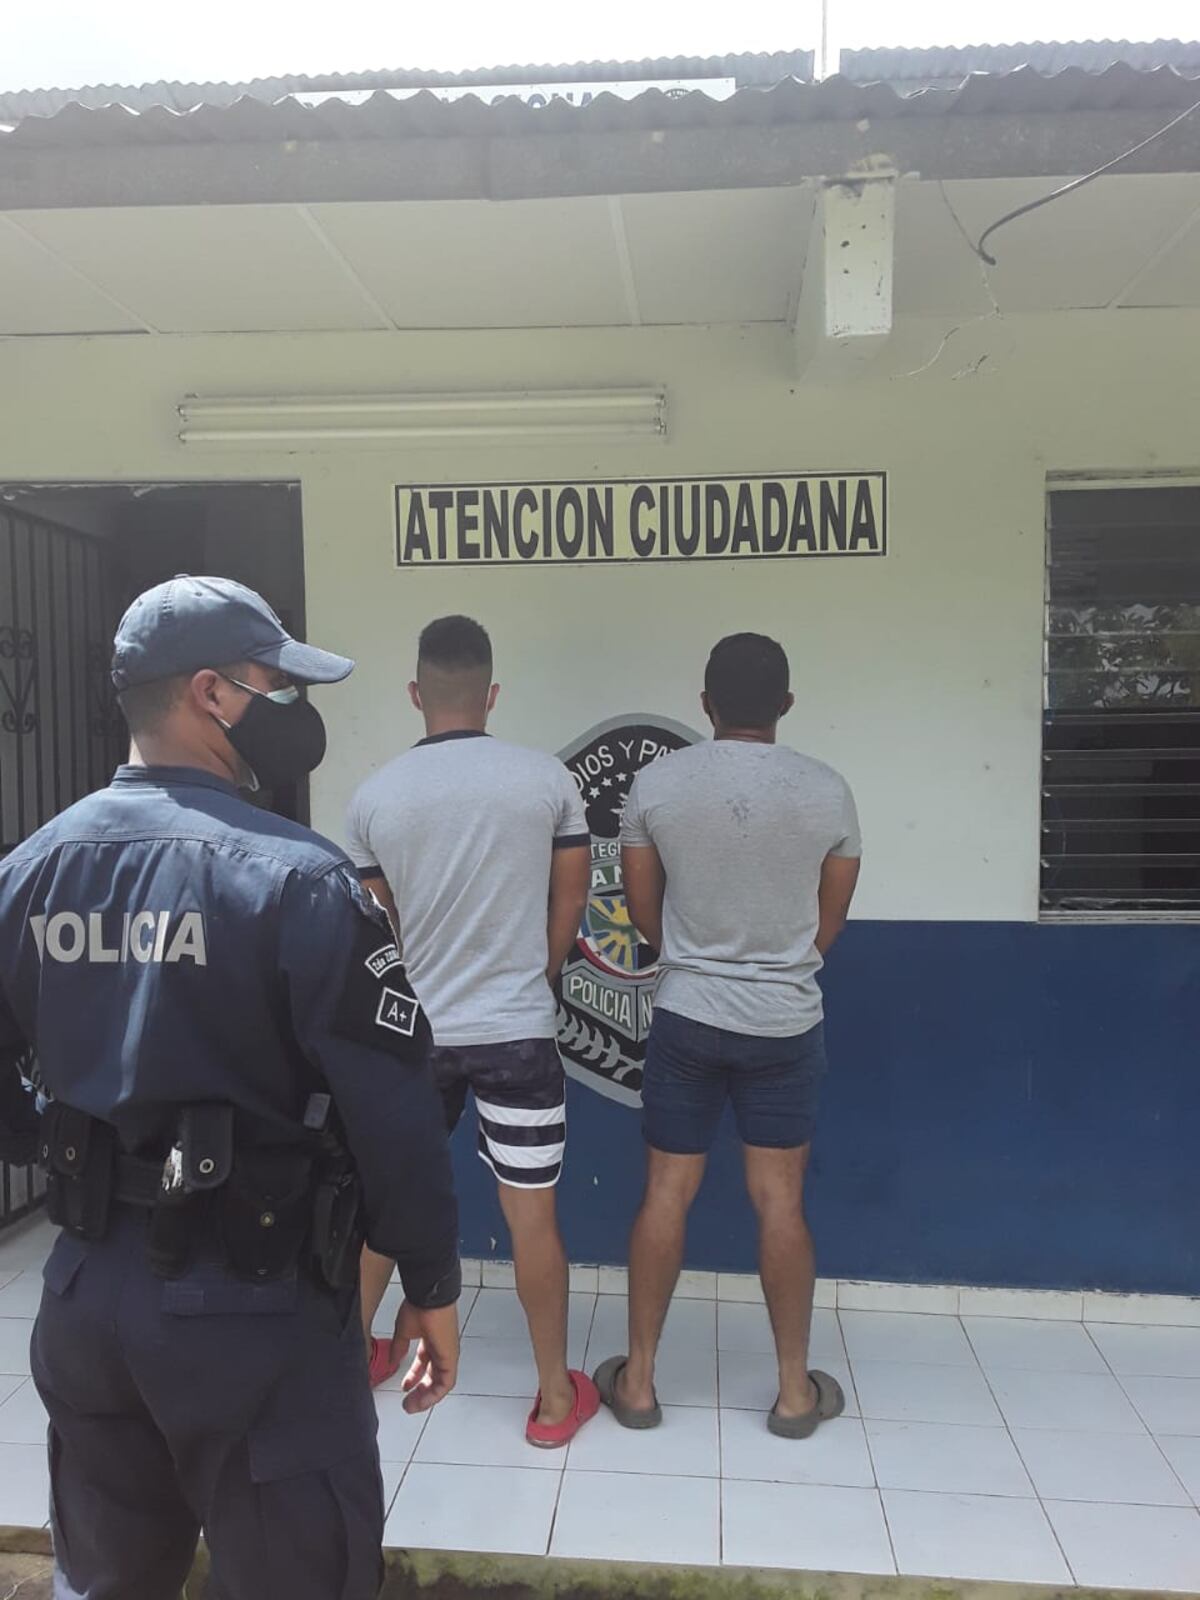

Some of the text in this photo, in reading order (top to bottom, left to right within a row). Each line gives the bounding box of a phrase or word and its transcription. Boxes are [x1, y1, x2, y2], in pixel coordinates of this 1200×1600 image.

[403, 479, 879, 560] ATENCION CIUDADANA
[618, 739, 635, 760] Y
[387, 1001, 407, 1022] A+
[570, 976, 632, 1028] POLICIA
